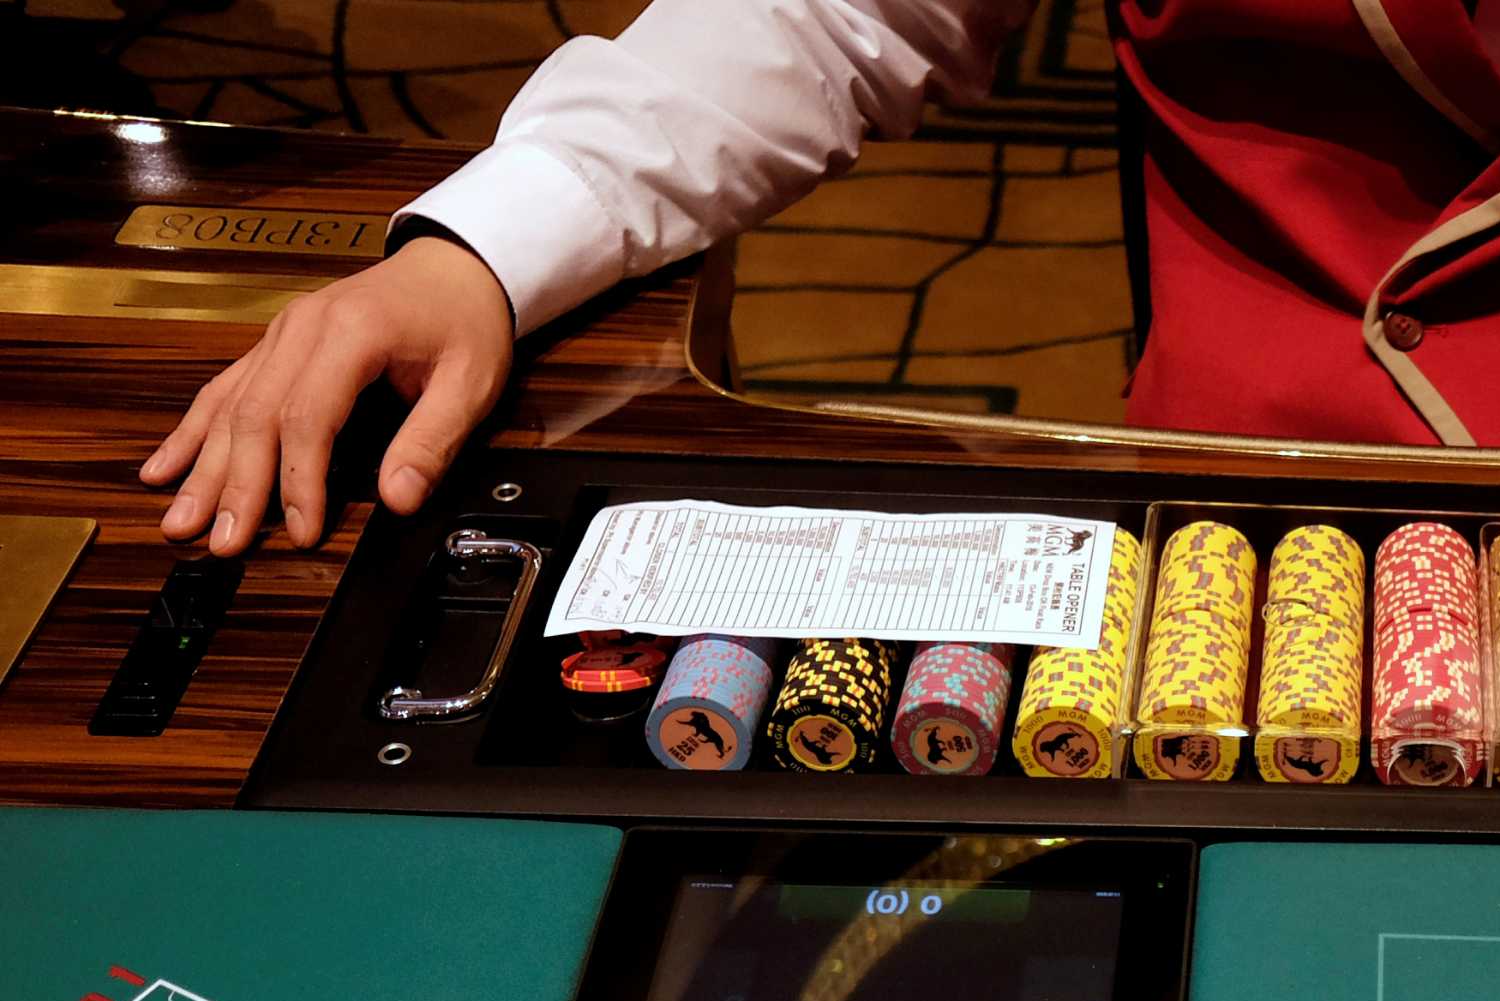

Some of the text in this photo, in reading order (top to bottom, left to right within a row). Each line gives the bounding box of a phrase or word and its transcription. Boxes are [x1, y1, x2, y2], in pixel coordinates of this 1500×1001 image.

[155, 213, 369, 248] 13PB08
[1042, 524, 1062, 557] MGM
[1062, 562, 1086, 633] TABLE OPENER
[830, 708, 858, 728] MGM
[1058, 710, 1088, 722] MGM
[1176, 709, 1206, 719] MGM
[1301, 712, 1330, 723] MGM
[775, 724, 784, 749] MGM
[668, 746, 686, 762] HKD
[677, 740, 696, 757] 25
[1019, 745, 1033, 769] MGM
[109, 965, 146, 987] 1
